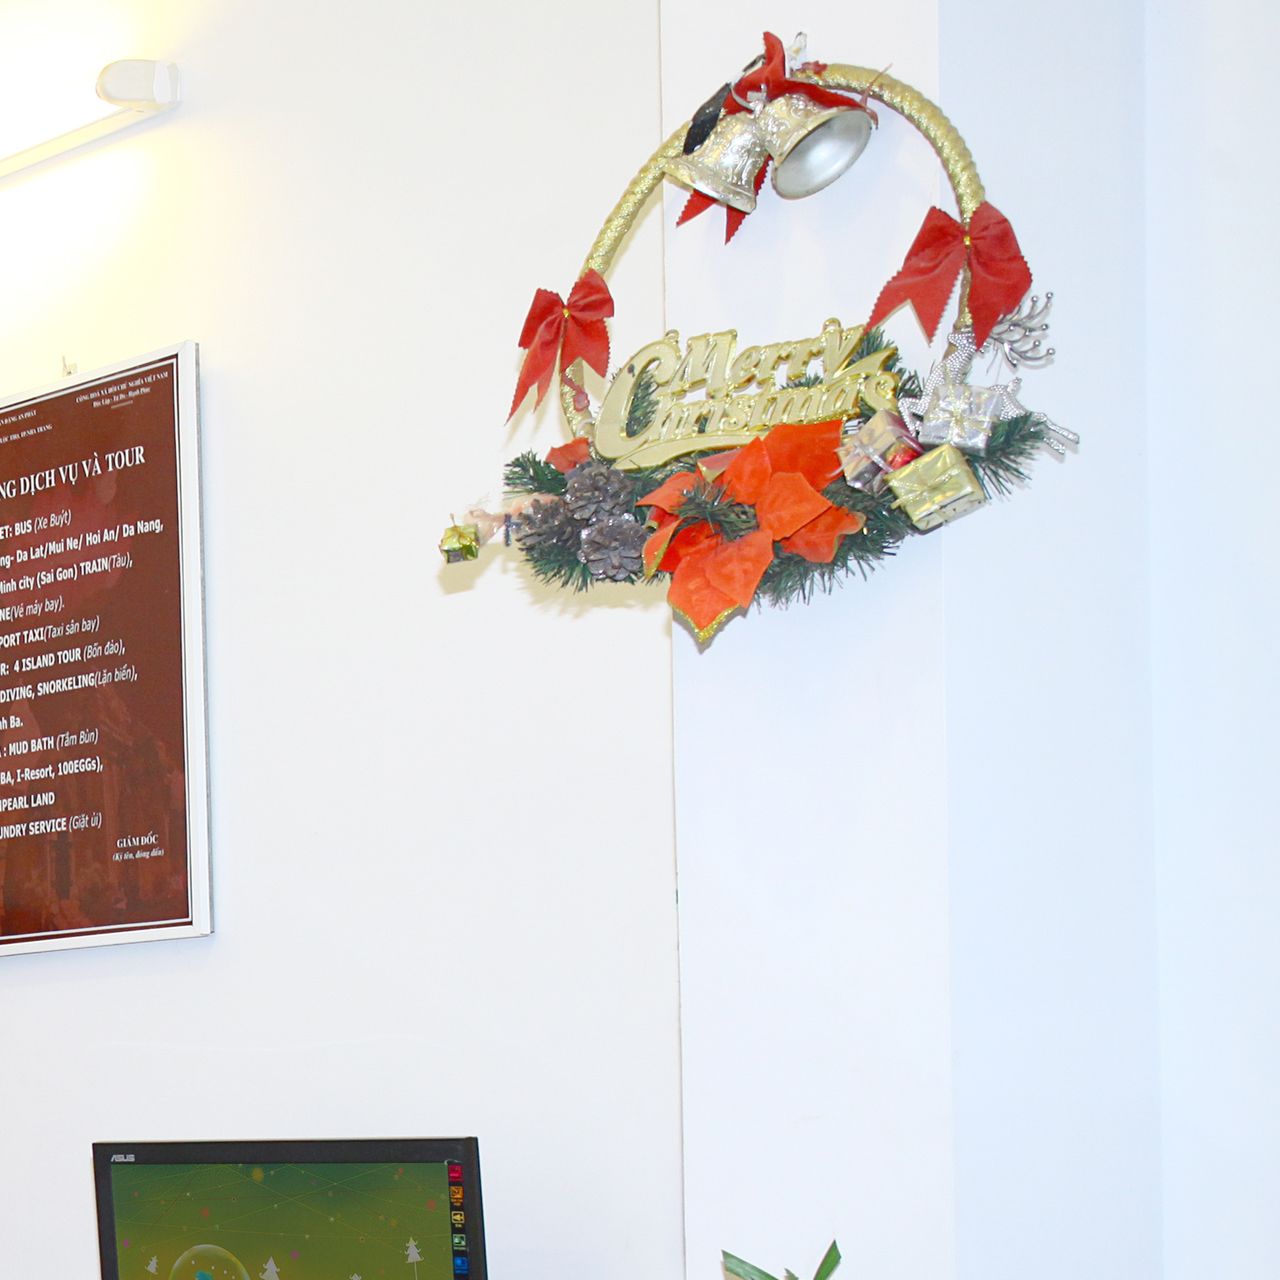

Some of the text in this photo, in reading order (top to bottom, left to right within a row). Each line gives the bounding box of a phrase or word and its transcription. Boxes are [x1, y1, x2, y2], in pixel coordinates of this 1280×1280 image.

[670, 319, 867, 394] Merry
[595, 342, 900, 468] Christmas
[20, 470, 56, 495] DỊCH
[59, 463, 78, 486] VỤ
[82, 452, 101, 476] VÀ
[106, 447, 146, 472] TOUR
[14, 520, 32, 536] BUS
[34, 516, 47, 533] (Xe
[50, 510, 72, 528] Buýt)
[16, 548, 28, 563] Da
[67, 534, 82, 551] Ne/
[86, 530, 100, 545] Hoi
[104, 525, 120, 543] An/
[123, 523, 134, 538] Da
[137, 517, 163, 535] Nang,
[19, 572, 35, 591] city
[37, 570, 54, 589] (Sai
[56, 564, 78, 586] Gon)
[26, 601, 42, 617] máy
[81, 615, 100, 633] bay)
[14, 660, 20, 672] 4
[21, 652, 55, 671] ISLAND
[57, 648, 81, 665] TOUR
[0, 685, 35, 702] DIVING,
[10, 715, 23, 728] Ba.
[9, 739, 28, 756] MUD
[31, 736, 54, 752] BATH
[79, 728, 98, 745] Bùn)
[0, 770, 14, 786] BA,
[17, 763, 55, 782] I-Resort,
[58, 756, 103, 777] 100EGGs),
[31, 792, 55, 808] LAND
[29, 818, 66, 835] SERVICE
[117, 831, 158, 848] GIÁM ĐỐC
[110, 1154, 135, 1162] ASUS
